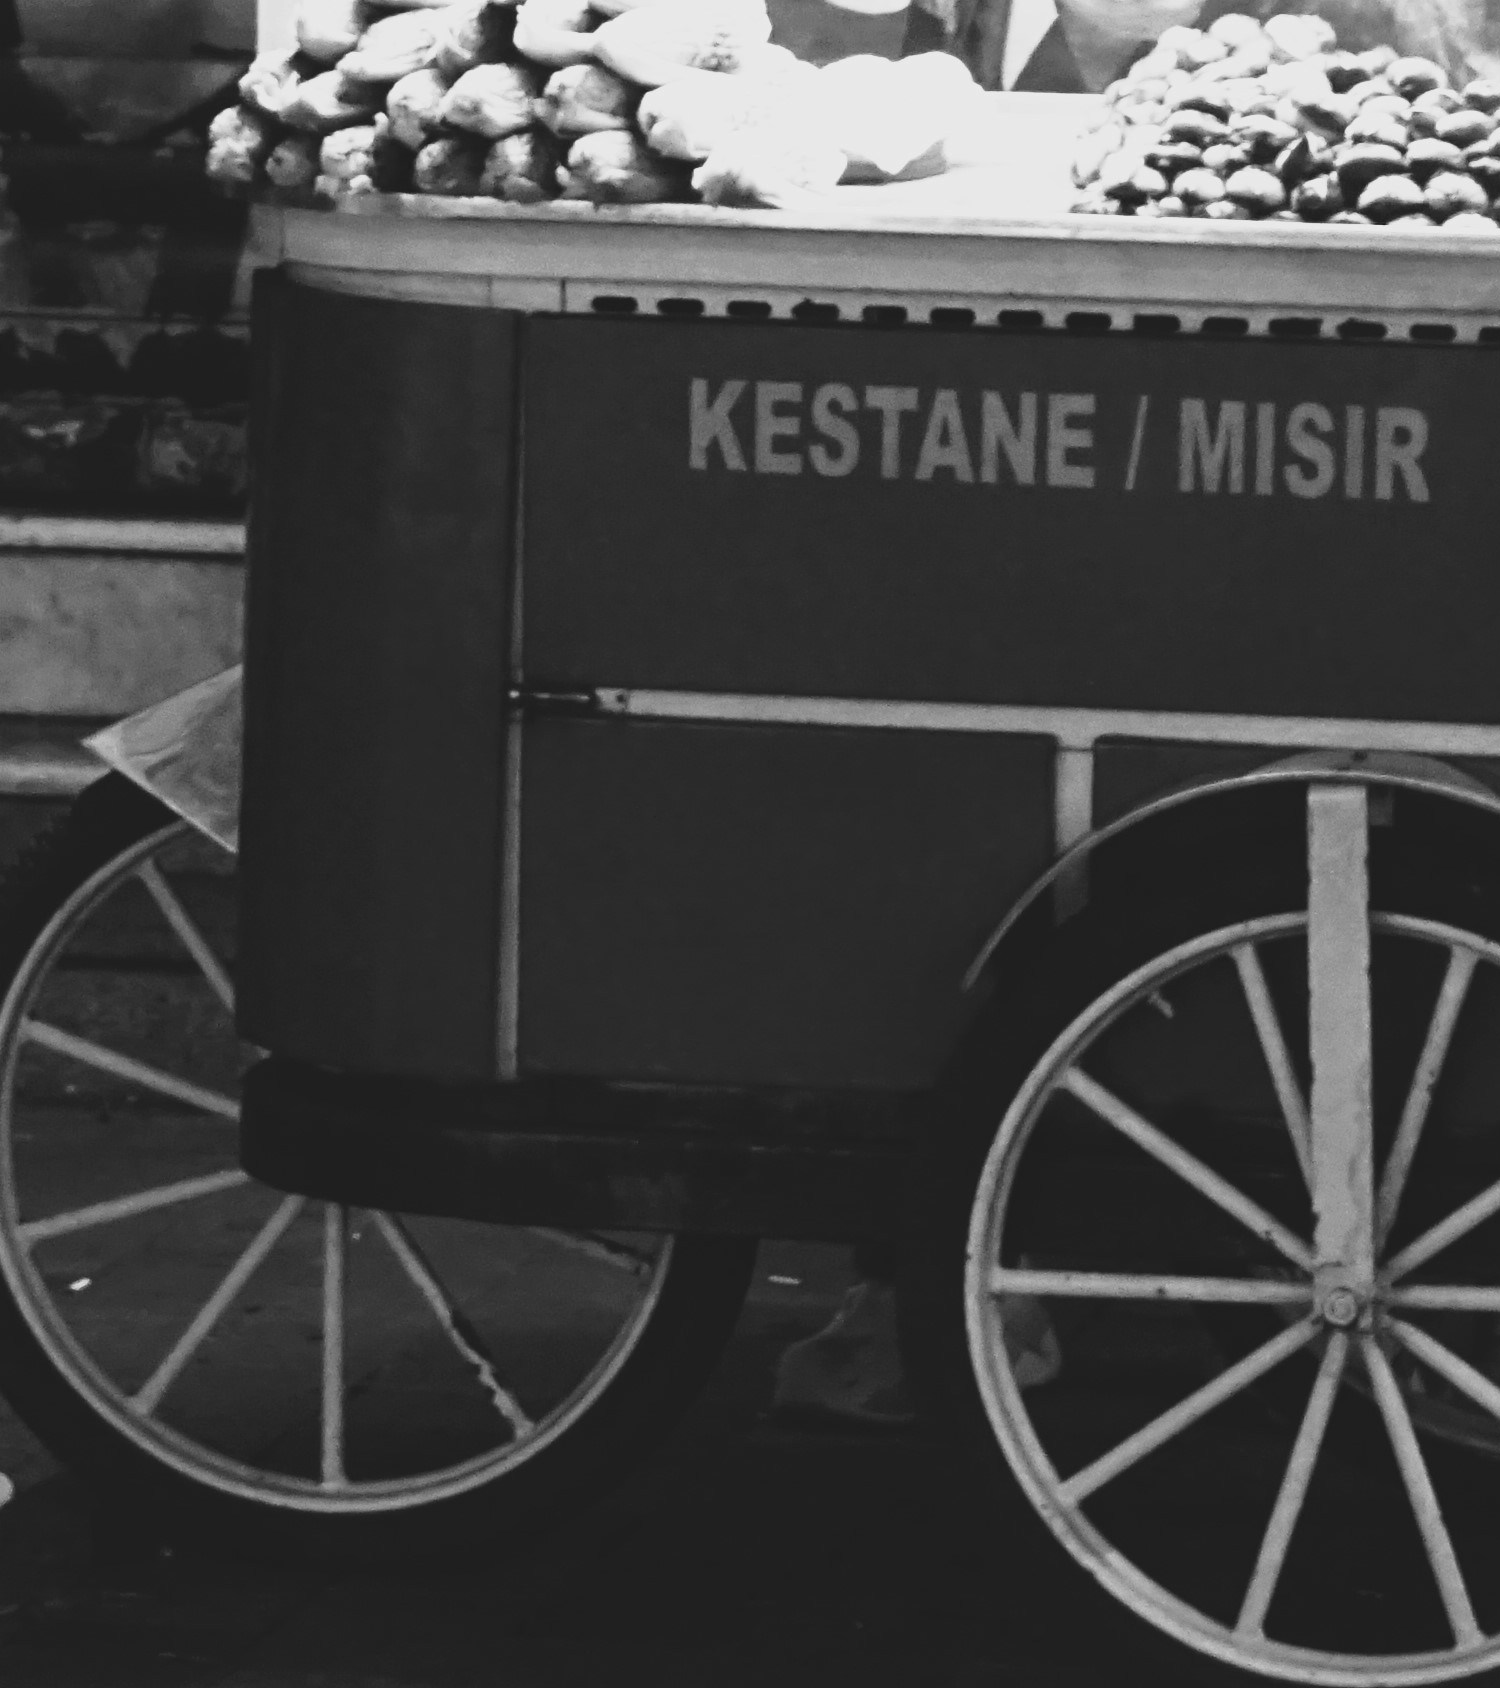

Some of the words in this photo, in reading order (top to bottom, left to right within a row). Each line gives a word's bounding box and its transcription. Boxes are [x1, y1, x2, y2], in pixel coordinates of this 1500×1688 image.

[688, 377, 1097, 489] KESTANE
[1125, 395, 1149, 491] /
[1178, 398, 1431, 503] MISIR
